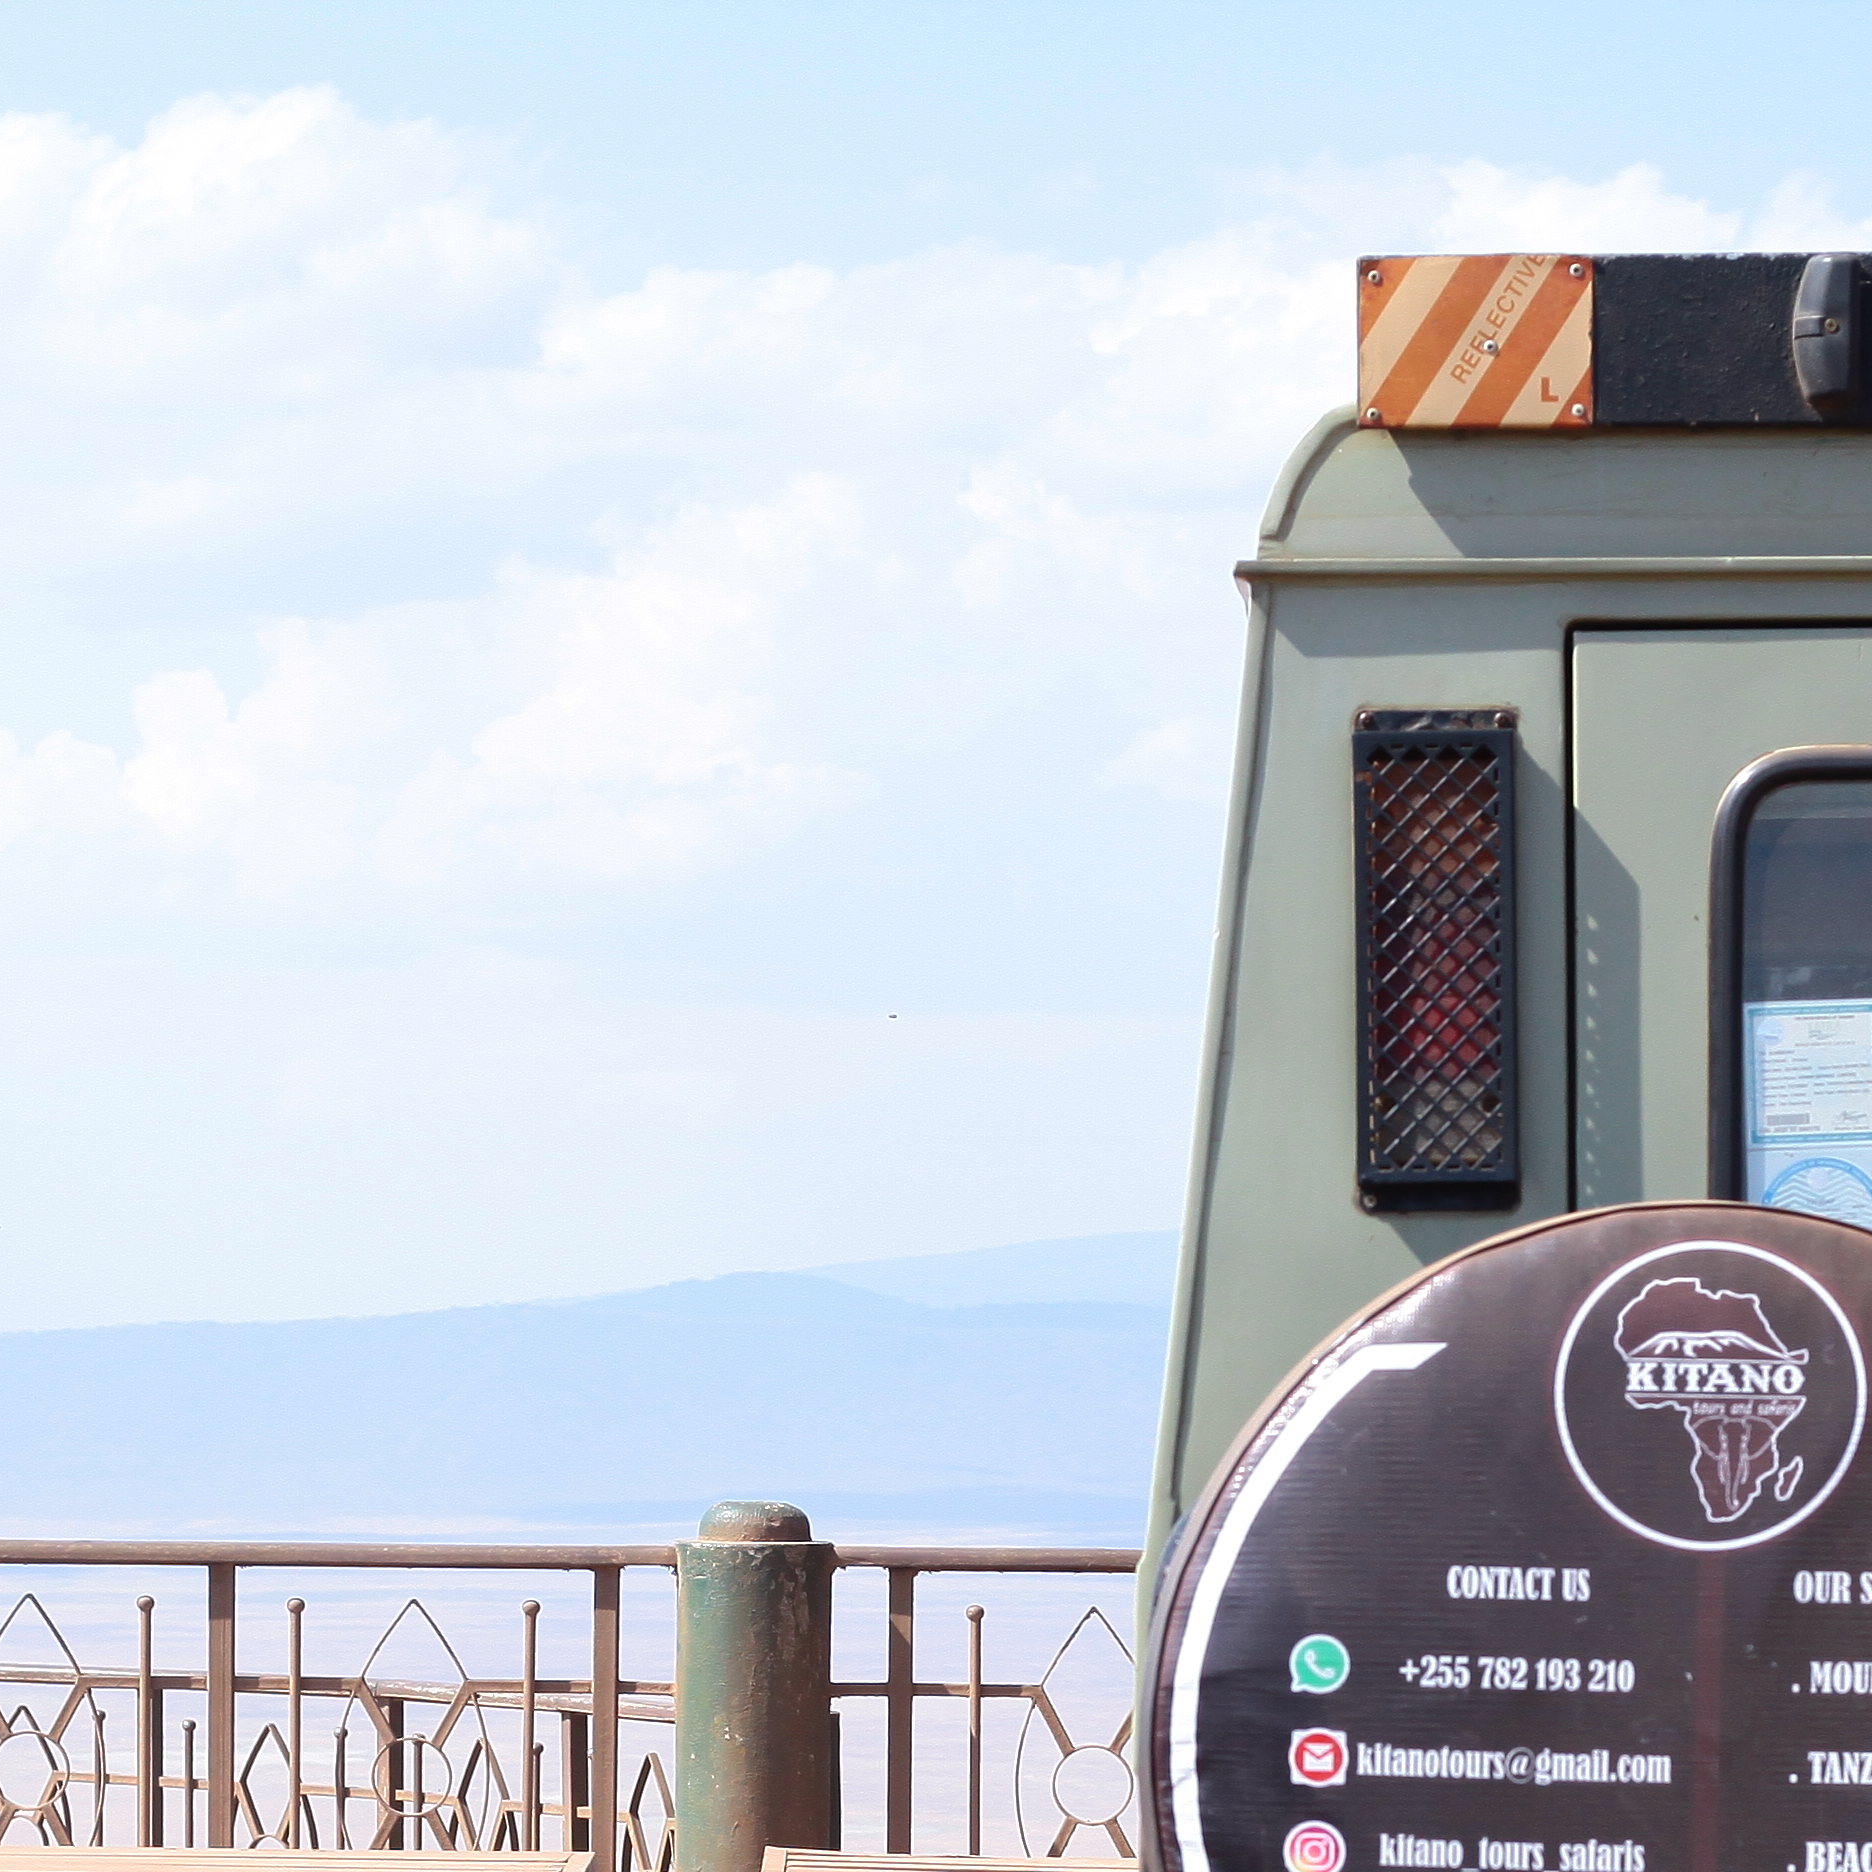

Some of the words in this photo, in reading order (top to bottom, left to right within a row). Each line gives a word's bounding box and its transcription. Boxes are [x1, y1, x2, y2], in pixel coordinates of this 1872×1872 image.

[1450, 255, 1546, 384] REFLECTIVE
[1541, 376, 1559, 402] L
[1626, 1362, 1805, 1394] KITANO
[1730, 1399, 1755, 1415] and
[1446, 1565, 1556, 1600] CONTACT
[1562, 1567, 1591, 1602] US
[1793, 1569, 1852, 1604] OUR
[1399, 1654, 1471, 1689] +255
[1478, 1656, 1528, 1691] 782
[1534, 1657, 1581, 1692] 193
[1587, 1659, 1636, 1693] 210
[1356, 1741, 1672, 1786] kitanotours@gmail.com
